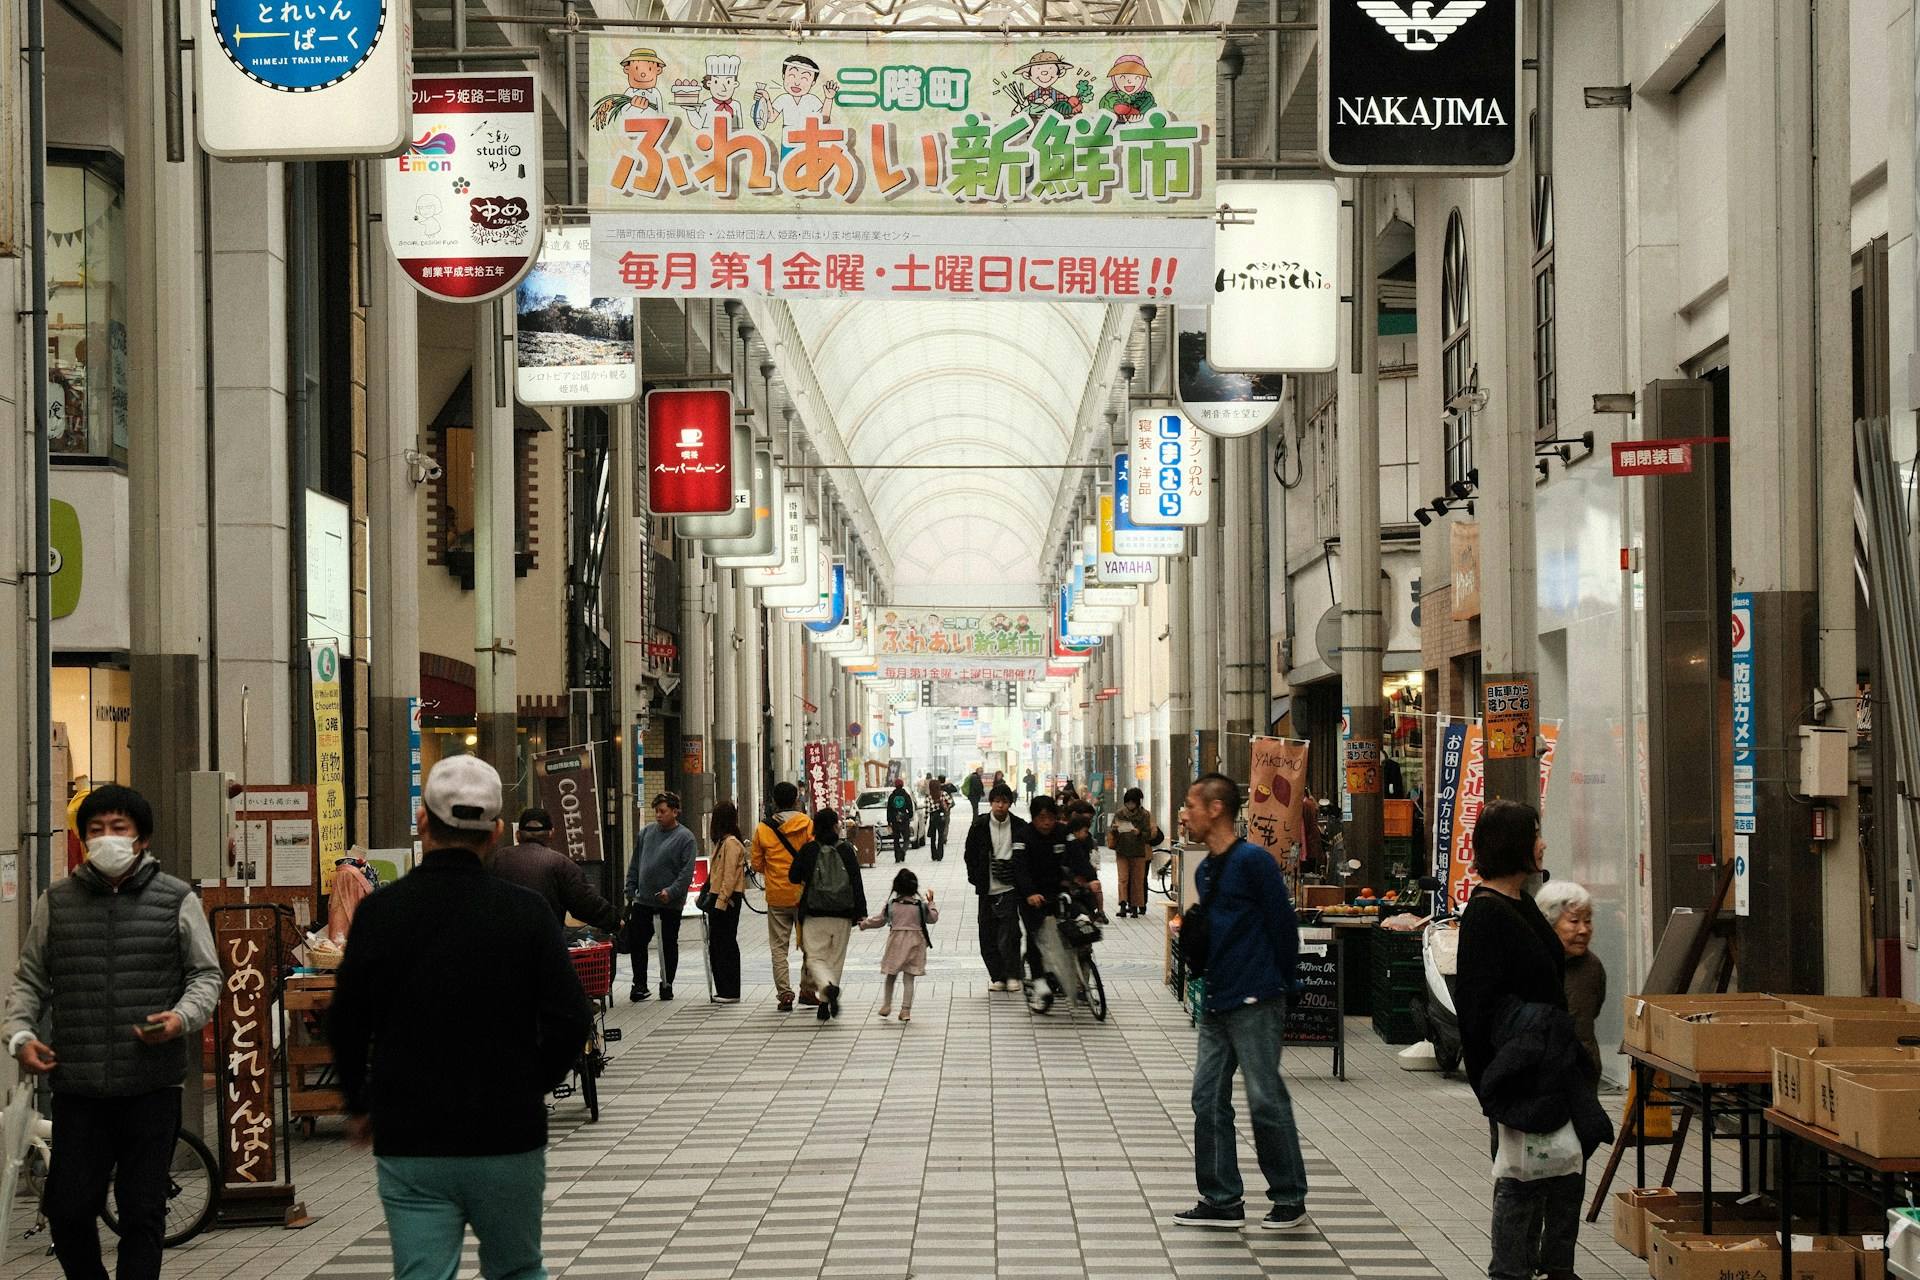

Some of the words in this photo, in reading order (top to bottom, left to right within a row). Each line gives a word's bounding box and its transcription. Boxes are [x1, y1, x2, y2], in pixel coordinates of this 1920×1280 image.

[294, 26, 359, 50] ぱーく
[252, 57, 288, 66] HIMEJI
[291, 56, 322, 65] TRAIN
[324, 55, 349, 63] PARK
[835, 66, 970, 111] 二階町
[1337, 97, 1509, 127] NAKAJIMA
[611, 112, 1199, 200] ふれあい新鮮市
[471, 199, 522, 222] ゆめ
[680, 449, 699, 460] 喫茶
[1138, 419, 1152, 496] 寝装・洋品
[1159, 415, 1181, 517] しまむら
[1620, 447, 1684, 467] 開閉装置
[654, 462, 726, 474] ペーパームーン
[1105, 560, 1152, 574] YAMAHA
[883, 630, 1043, 654] ふれあい新鮮市
[1487, 684, 1530, 698] 自転車から
[1488, 697, 1531, 713] 降りてね
[1733, 662, 1751, 762] 防犯カメラ
[321, 752, 341, 773] 着物
[559, 778, 586, 858] COFFEE
[321, 824, 344, 841] 着付け
[227, 937, 273, 1182] ひめじとれいんぱーく
